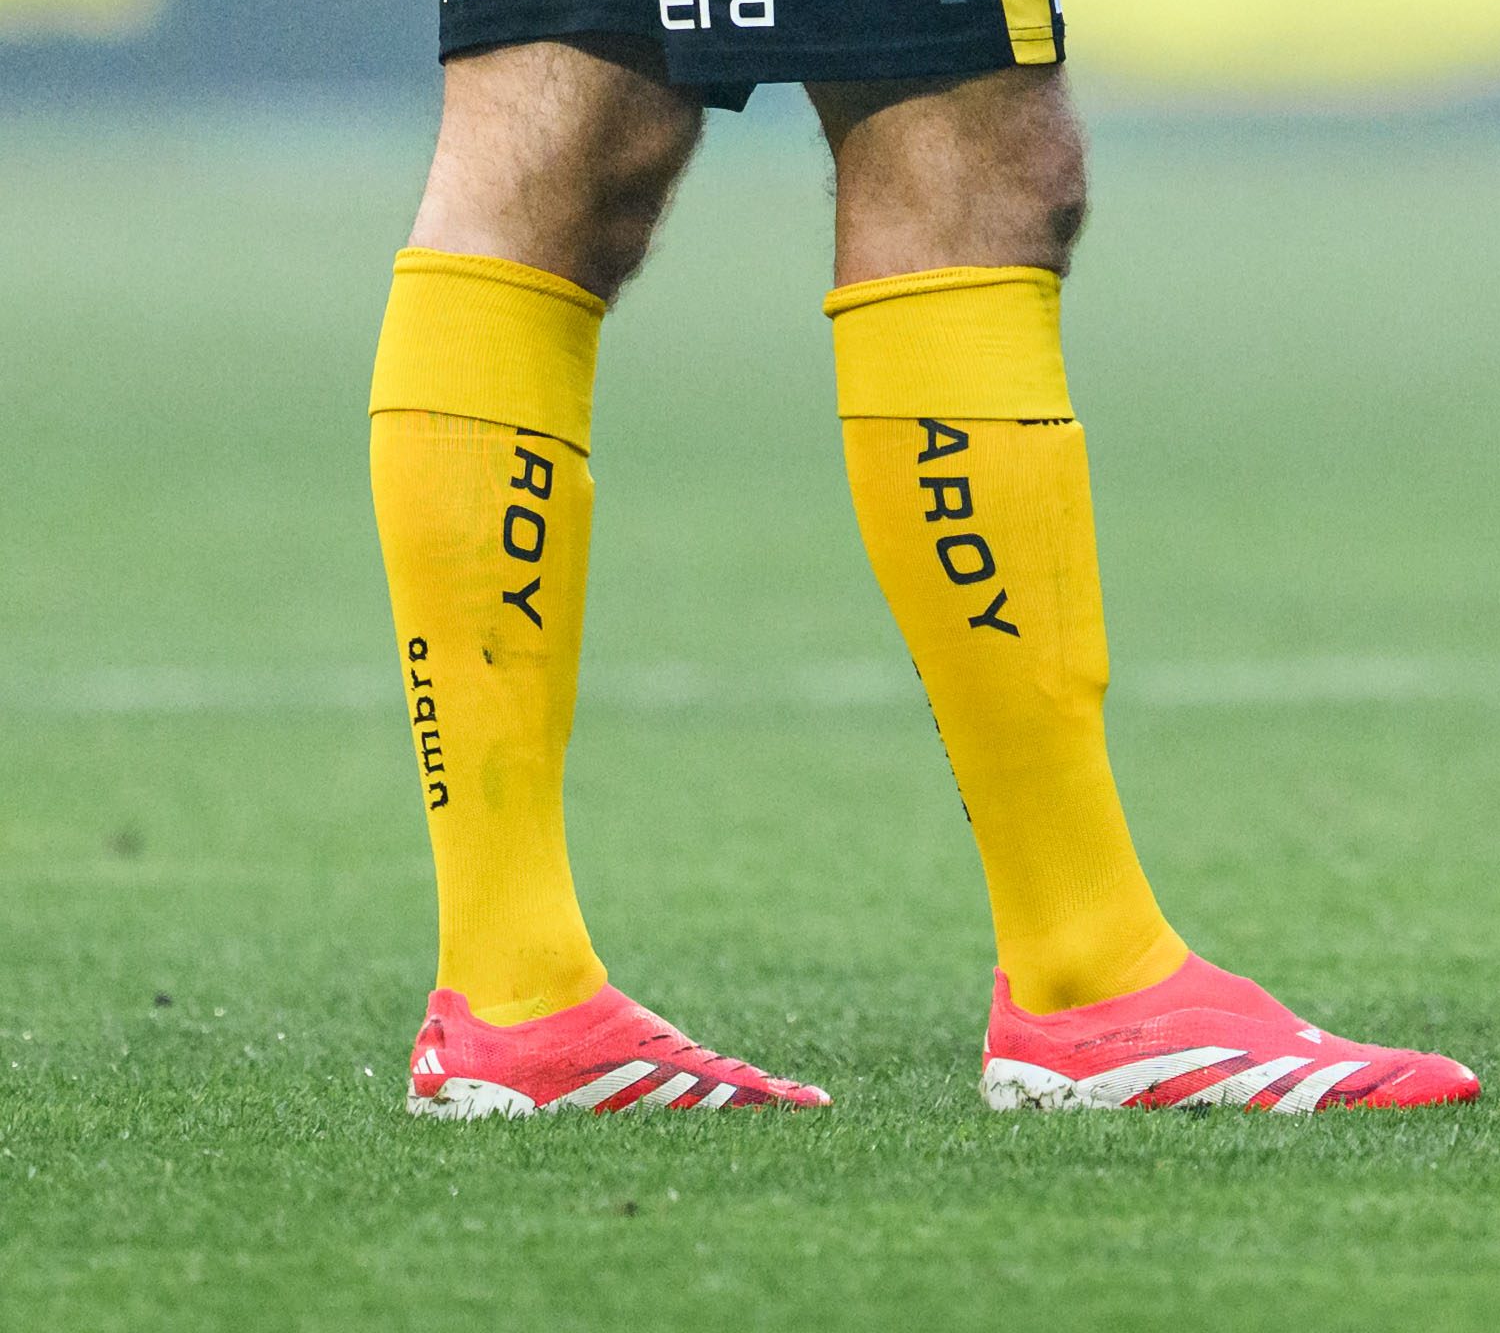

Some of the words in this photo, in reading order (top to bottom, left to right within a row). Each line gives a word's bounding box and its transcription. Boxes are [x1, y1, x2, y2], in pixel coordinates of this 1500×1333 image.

[502, 428, 555, 631] ROY
[917, 418, 1021, 639] AROY
[408, 636, 449, 811] umbro
